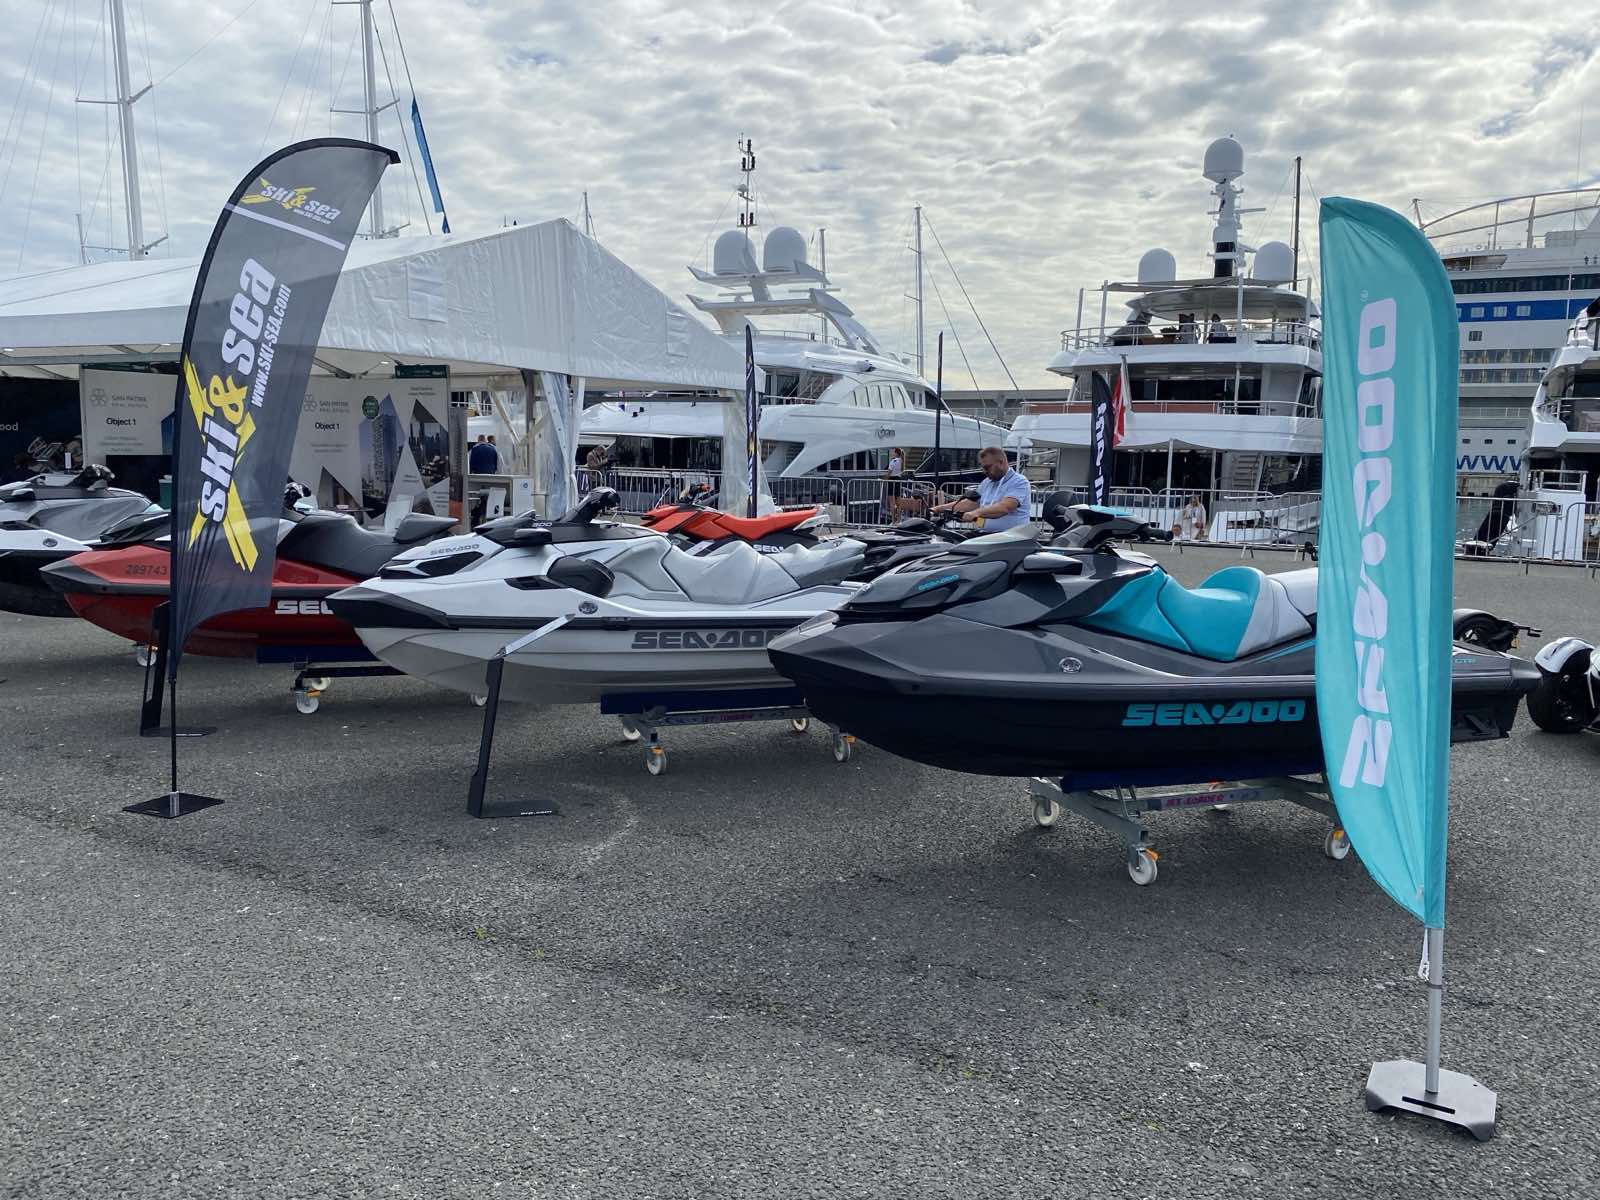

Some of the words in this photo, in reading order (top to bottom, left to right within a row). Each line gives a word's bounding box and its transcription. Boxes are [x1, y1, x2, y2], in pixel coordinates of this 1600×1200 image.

[221, 258, 276, 376] sea
[209, 374, 248, 425] &
[106, 417, 131, 427] Object
[315, 422, 336, 431] Object
